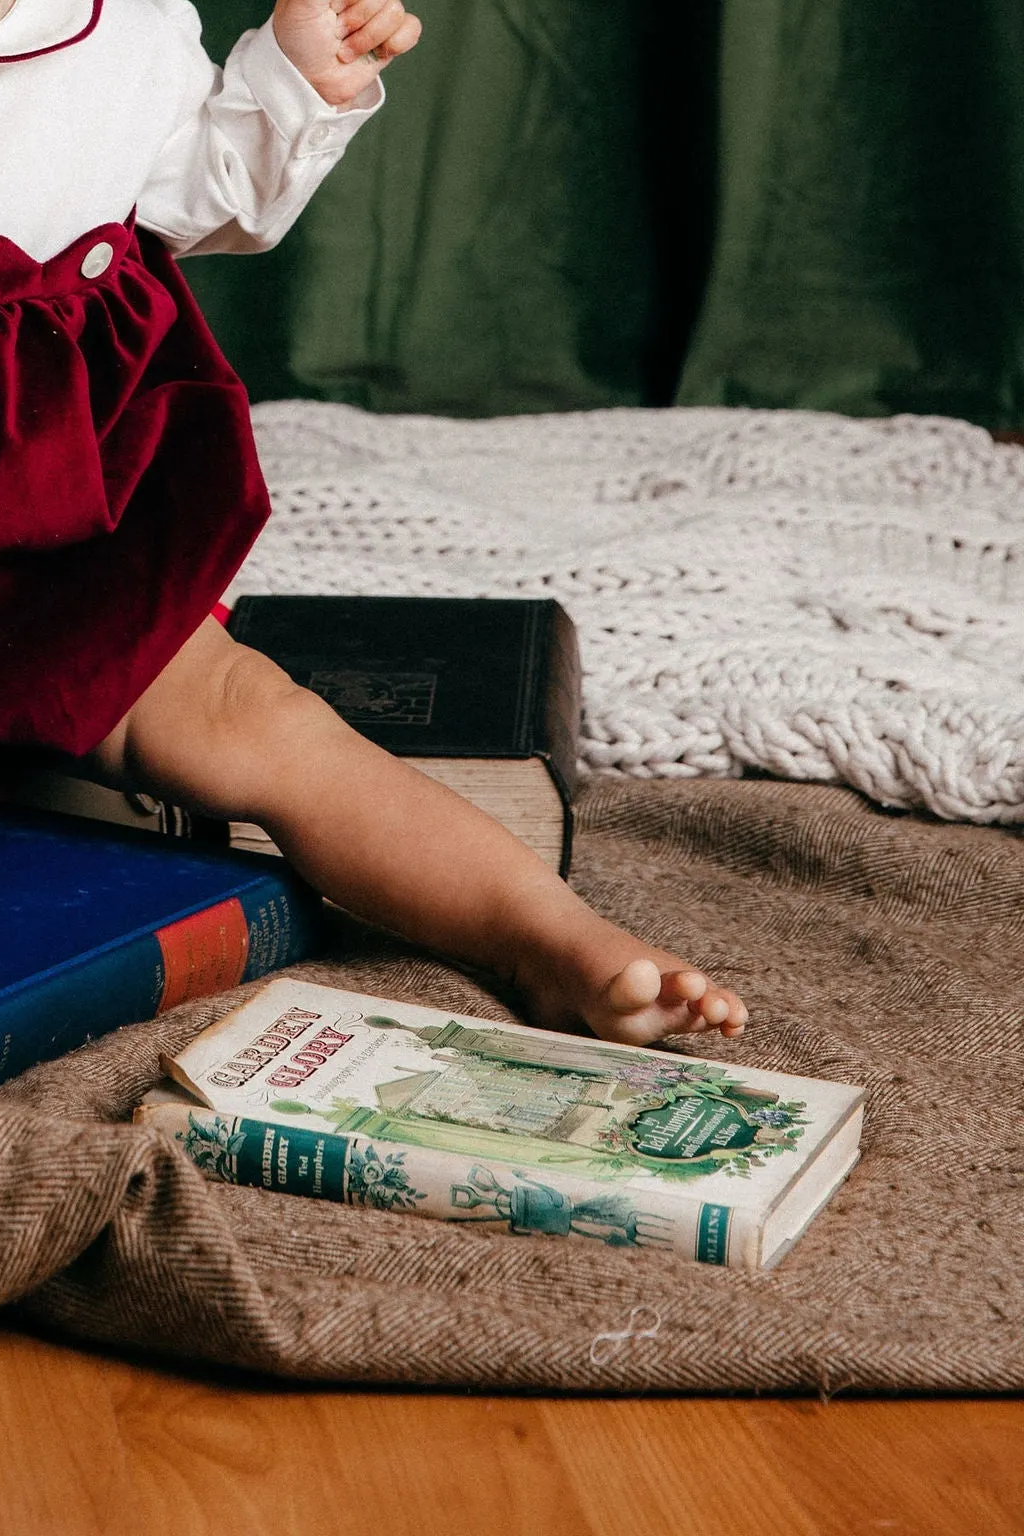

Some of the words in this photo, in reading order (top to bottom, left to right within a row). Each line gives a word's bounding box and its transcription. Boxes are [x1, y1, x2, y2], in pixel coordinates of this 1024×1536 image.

[208, 1006, 321, 1088] GARDEN
[264, 1026, 355, 1087] GLORY
[636, 1116, 660, 1128] by
[637, 1132, 670, 1151] Ted
[651, 1097, 703, 1138] Humphris
[262, 1127, 275, 1187] GARDEN
[277, 1135, 289, 1185] GLORY
[298, 1155, 309, 1177] Ted
[313, 1139, 325, 1193] Humphris
